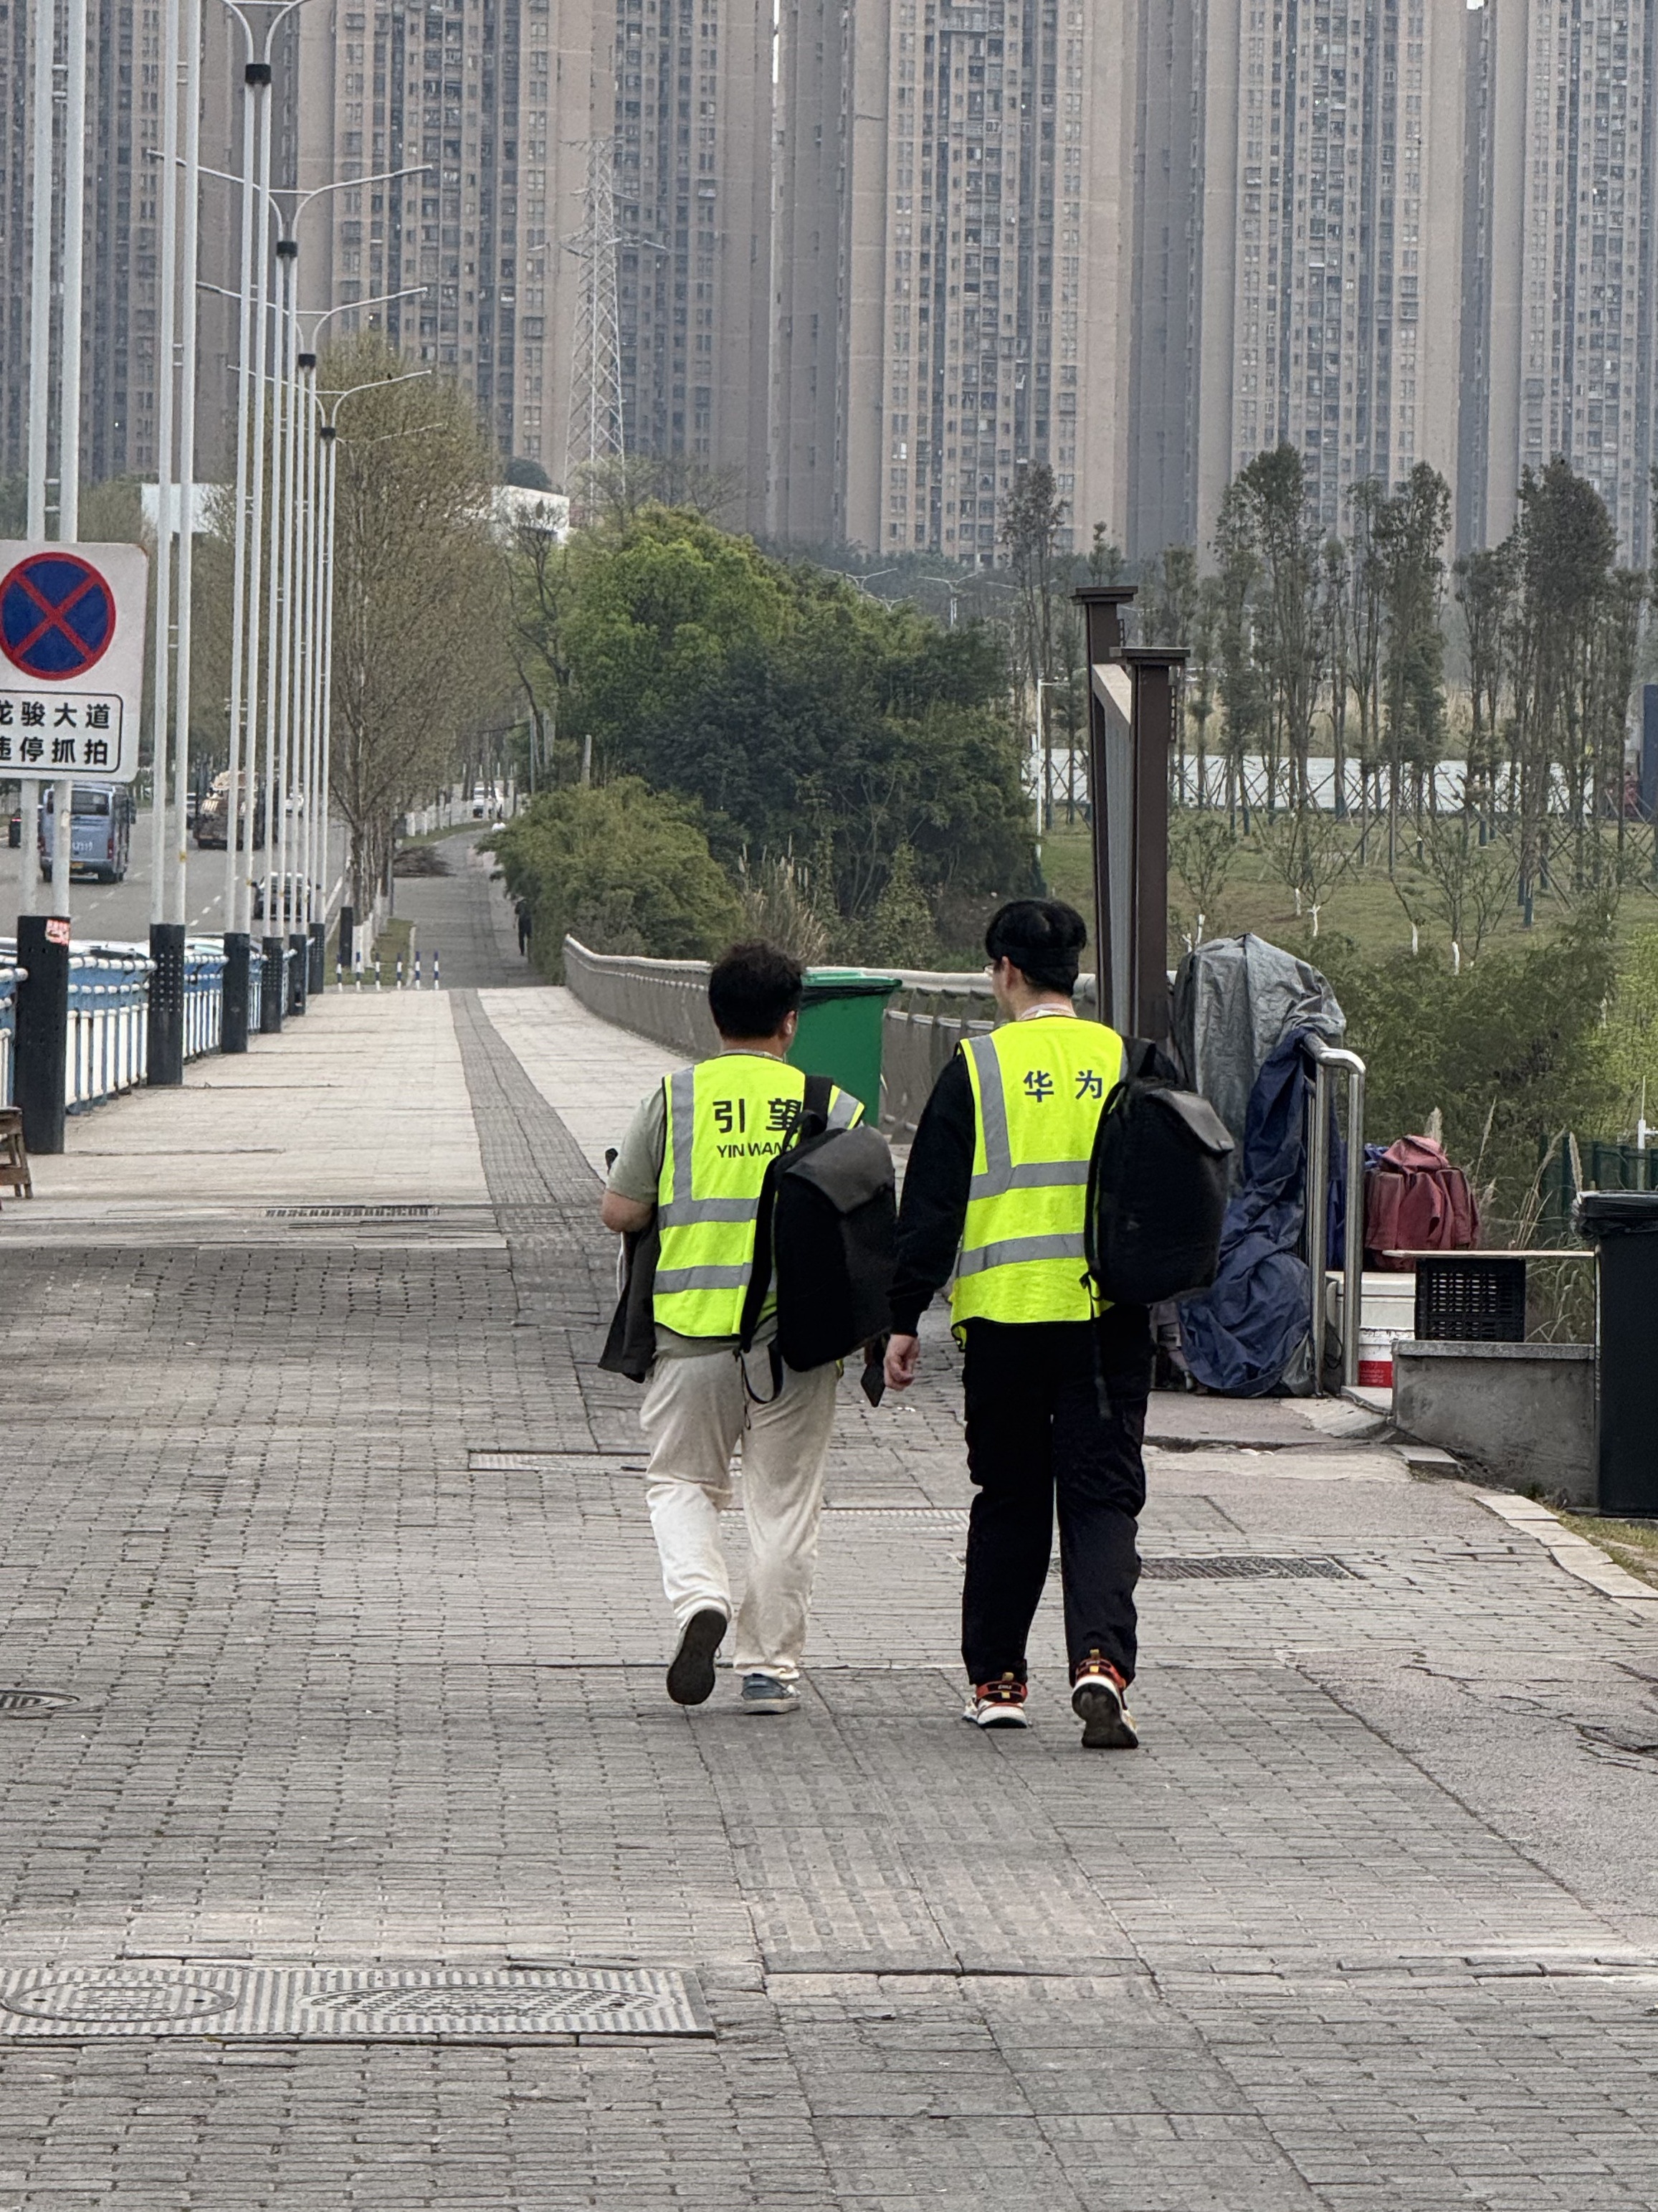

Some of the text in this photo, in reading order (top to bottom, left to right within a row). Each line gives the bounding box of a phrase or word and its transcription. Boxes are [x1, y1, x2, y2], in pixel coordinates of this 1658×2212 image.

[1023, 1069, 1102, 1103] 华为
[713, 1098, 802, 1134] 引望
[747, 1141, 792, 1157] WAN
